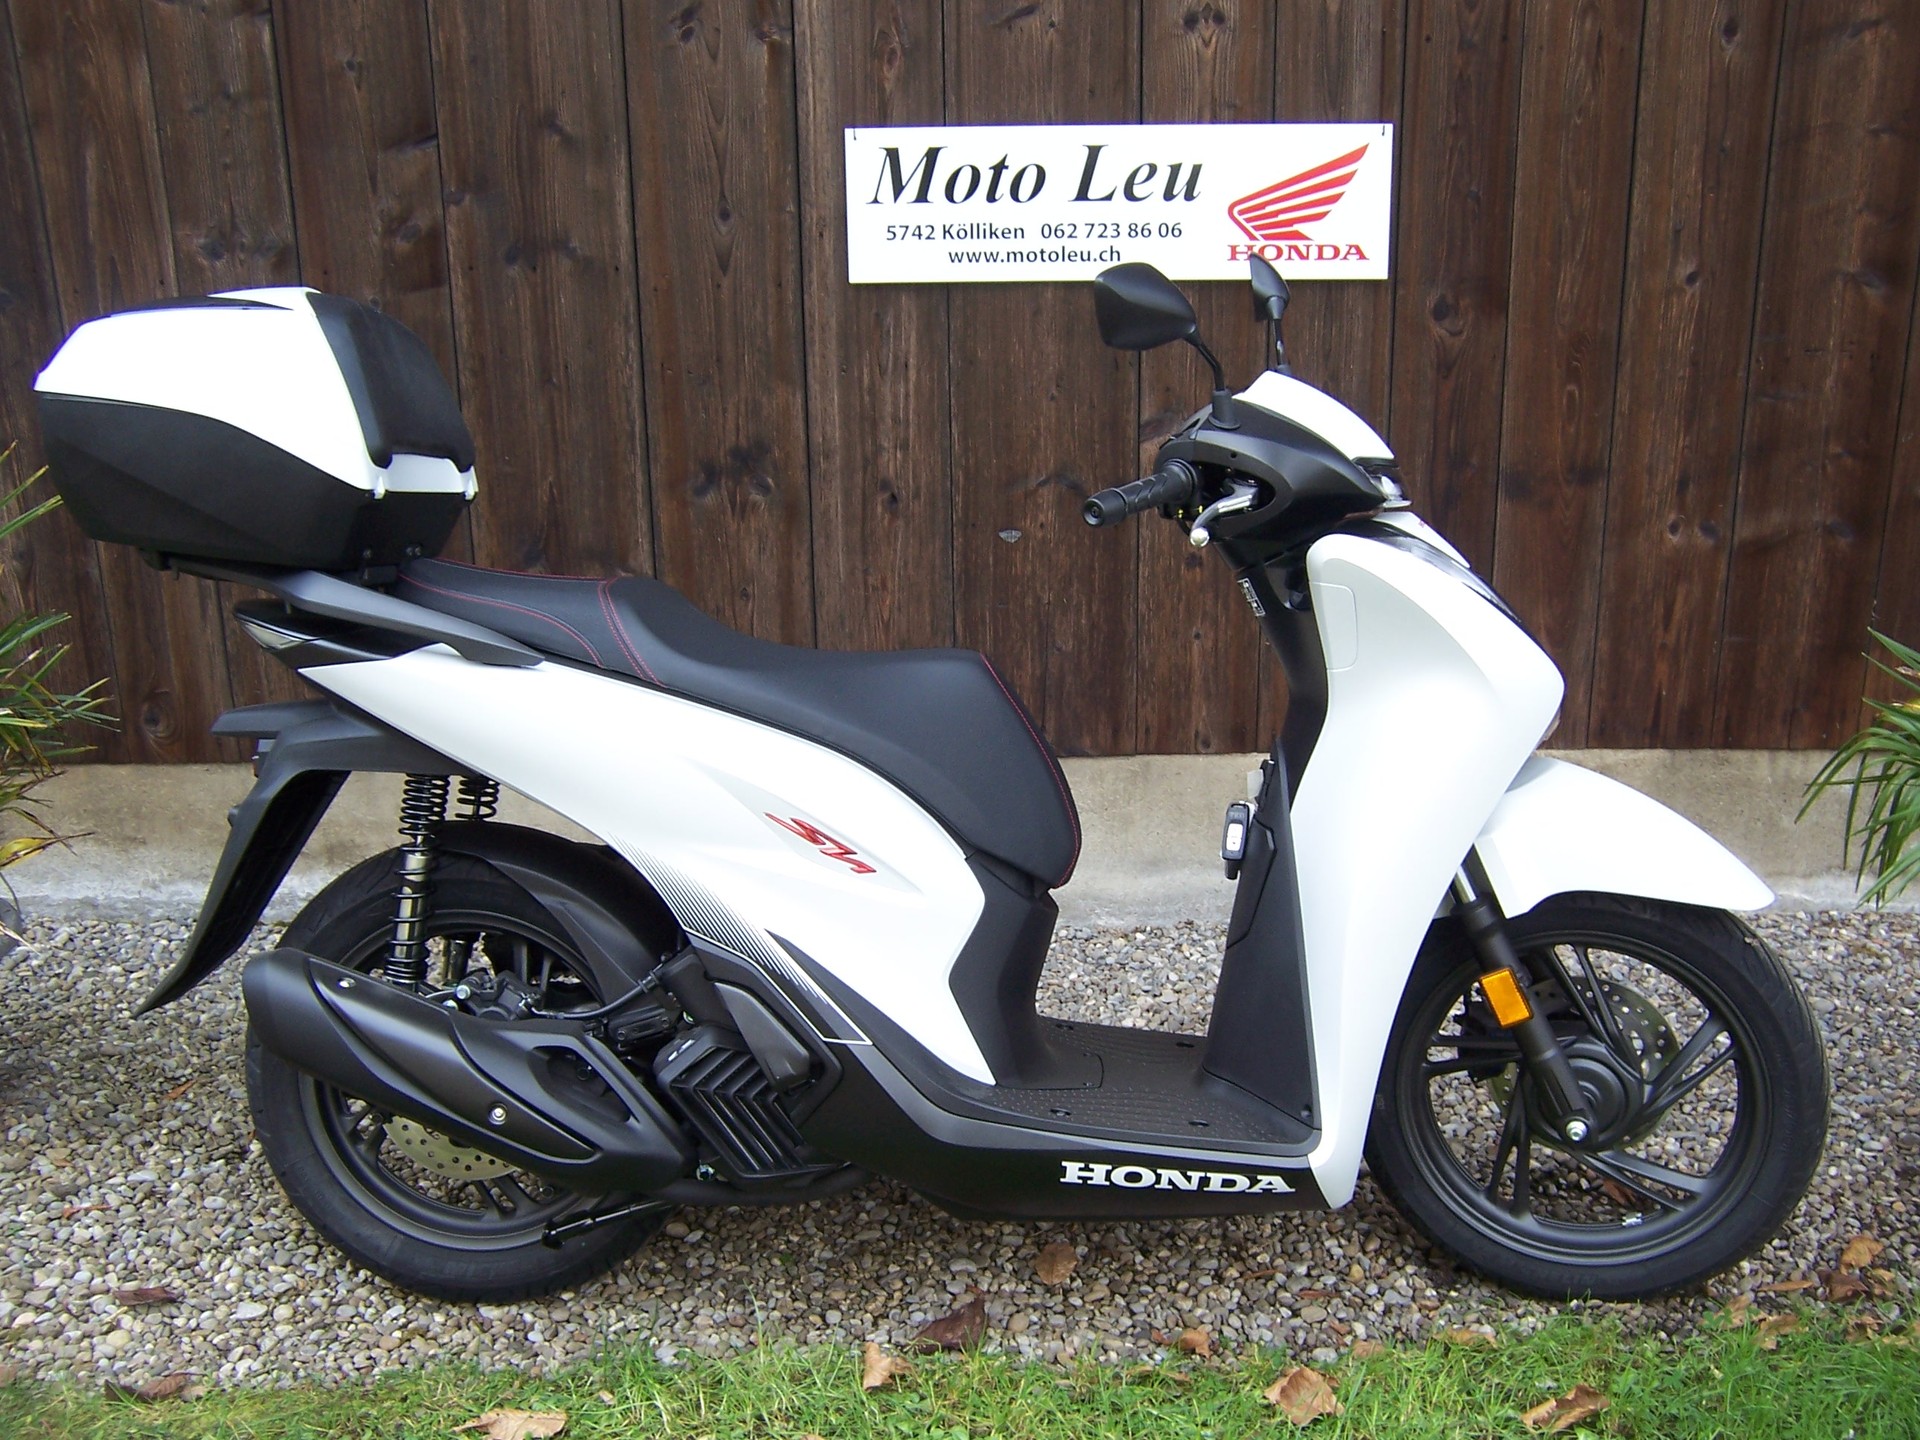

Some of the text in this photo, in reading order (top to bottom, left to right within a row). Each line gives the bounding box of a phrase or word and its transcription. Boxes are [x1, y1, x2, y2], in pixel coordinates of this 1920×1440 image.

[865, 144, 1203, 205] Moto Leu
[886, 222, 1182, 241] 5742 Kölliken 062 723 86 06
[948, 245, 1121, 263] www.motoleu.ch
[1227, 243, 1370, 262] HONDA
[1060, 1160, 1296, 1194] HONDA
